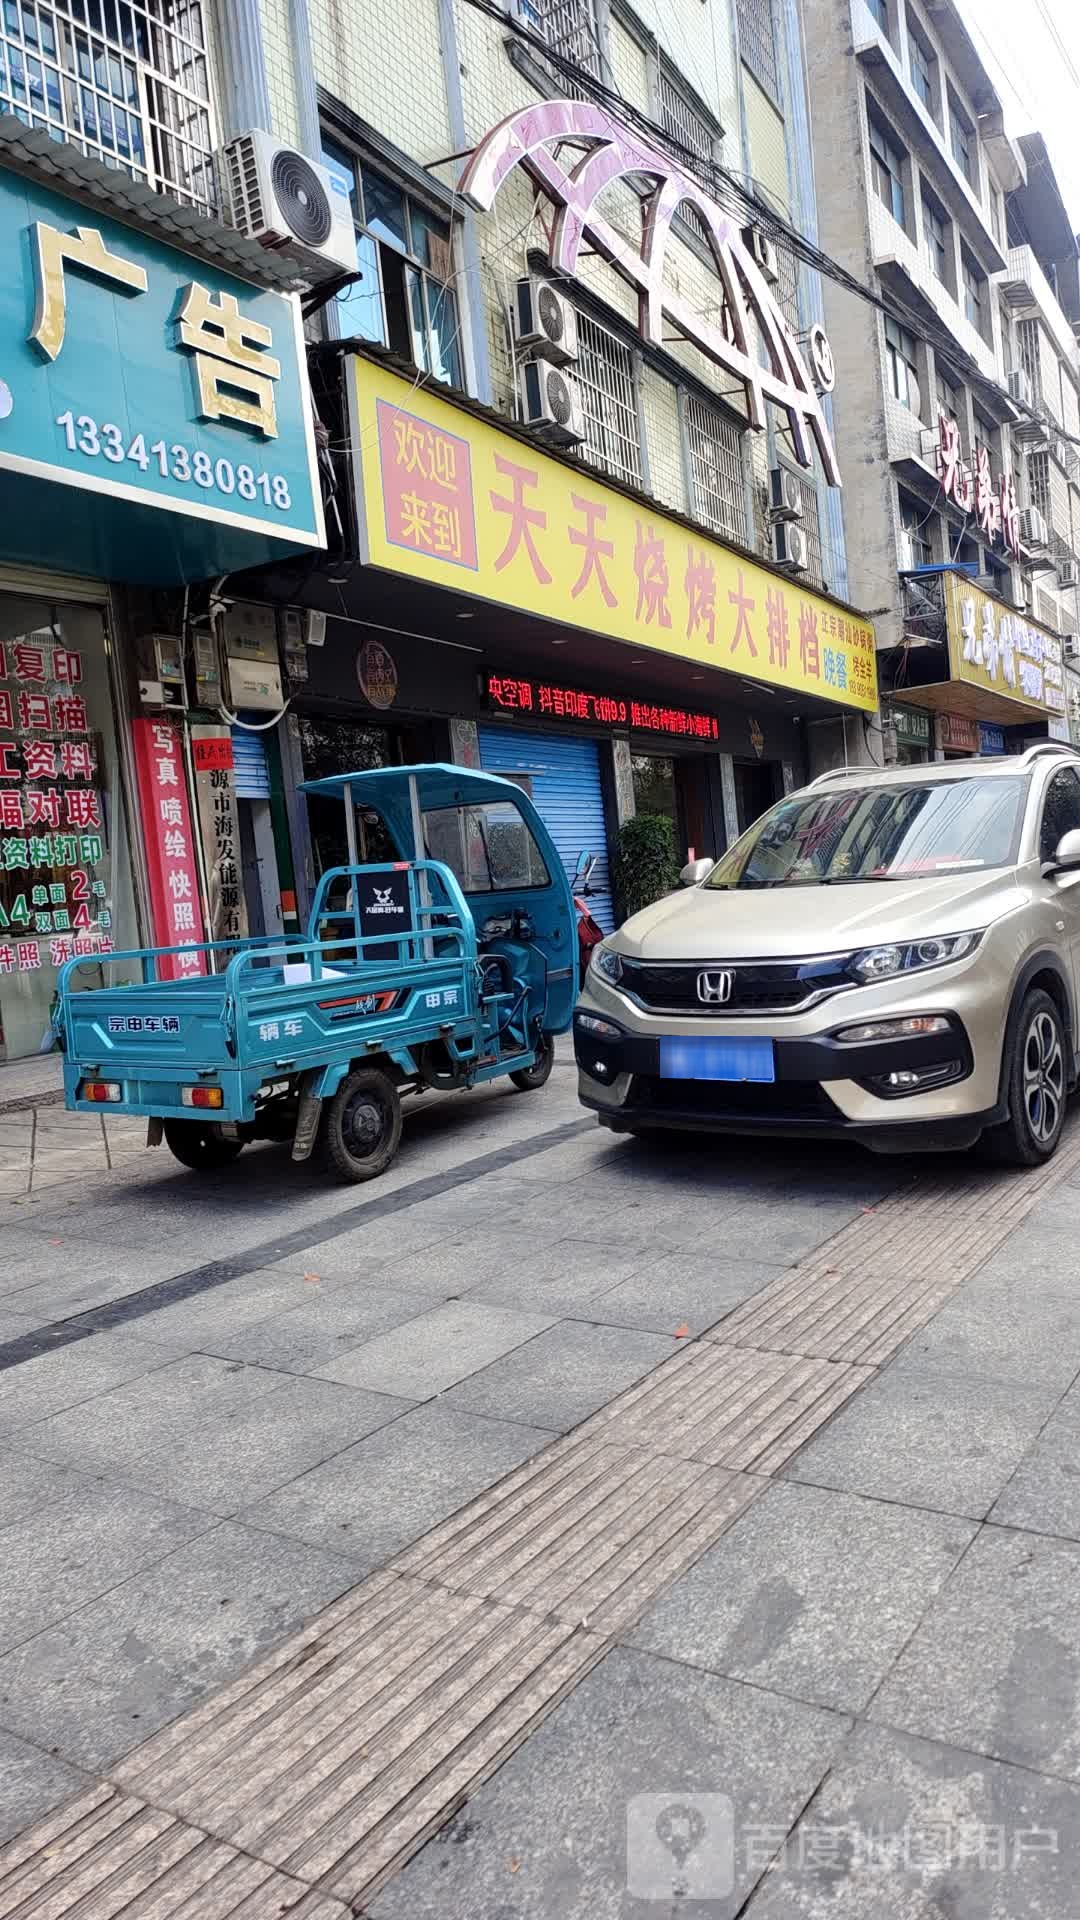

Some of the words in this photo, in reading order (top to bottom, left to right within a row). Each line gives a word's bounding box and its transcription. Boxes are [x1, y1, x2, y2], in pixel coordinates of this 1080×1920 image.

[27, 220, 281, 440] 广告
[56, 410, 292, 510] 13341380818
[393, 417, 457, 494] 欢迎
[399, 490, 462, 559] 来到
[489, 452, 821, 680] 天天烧烤大排档
[0, 641, 82, 686] 复印
[488, 674, 532, 711] 央空调
[151, 724, 179, 787] 写真
[0, 834, 103, 871] 资料打印
[160, 797, 187, 858] 喷绘
[169, 868, 196, 930] 快照
[108, 1015, 180, 1034] 宗申车辆
